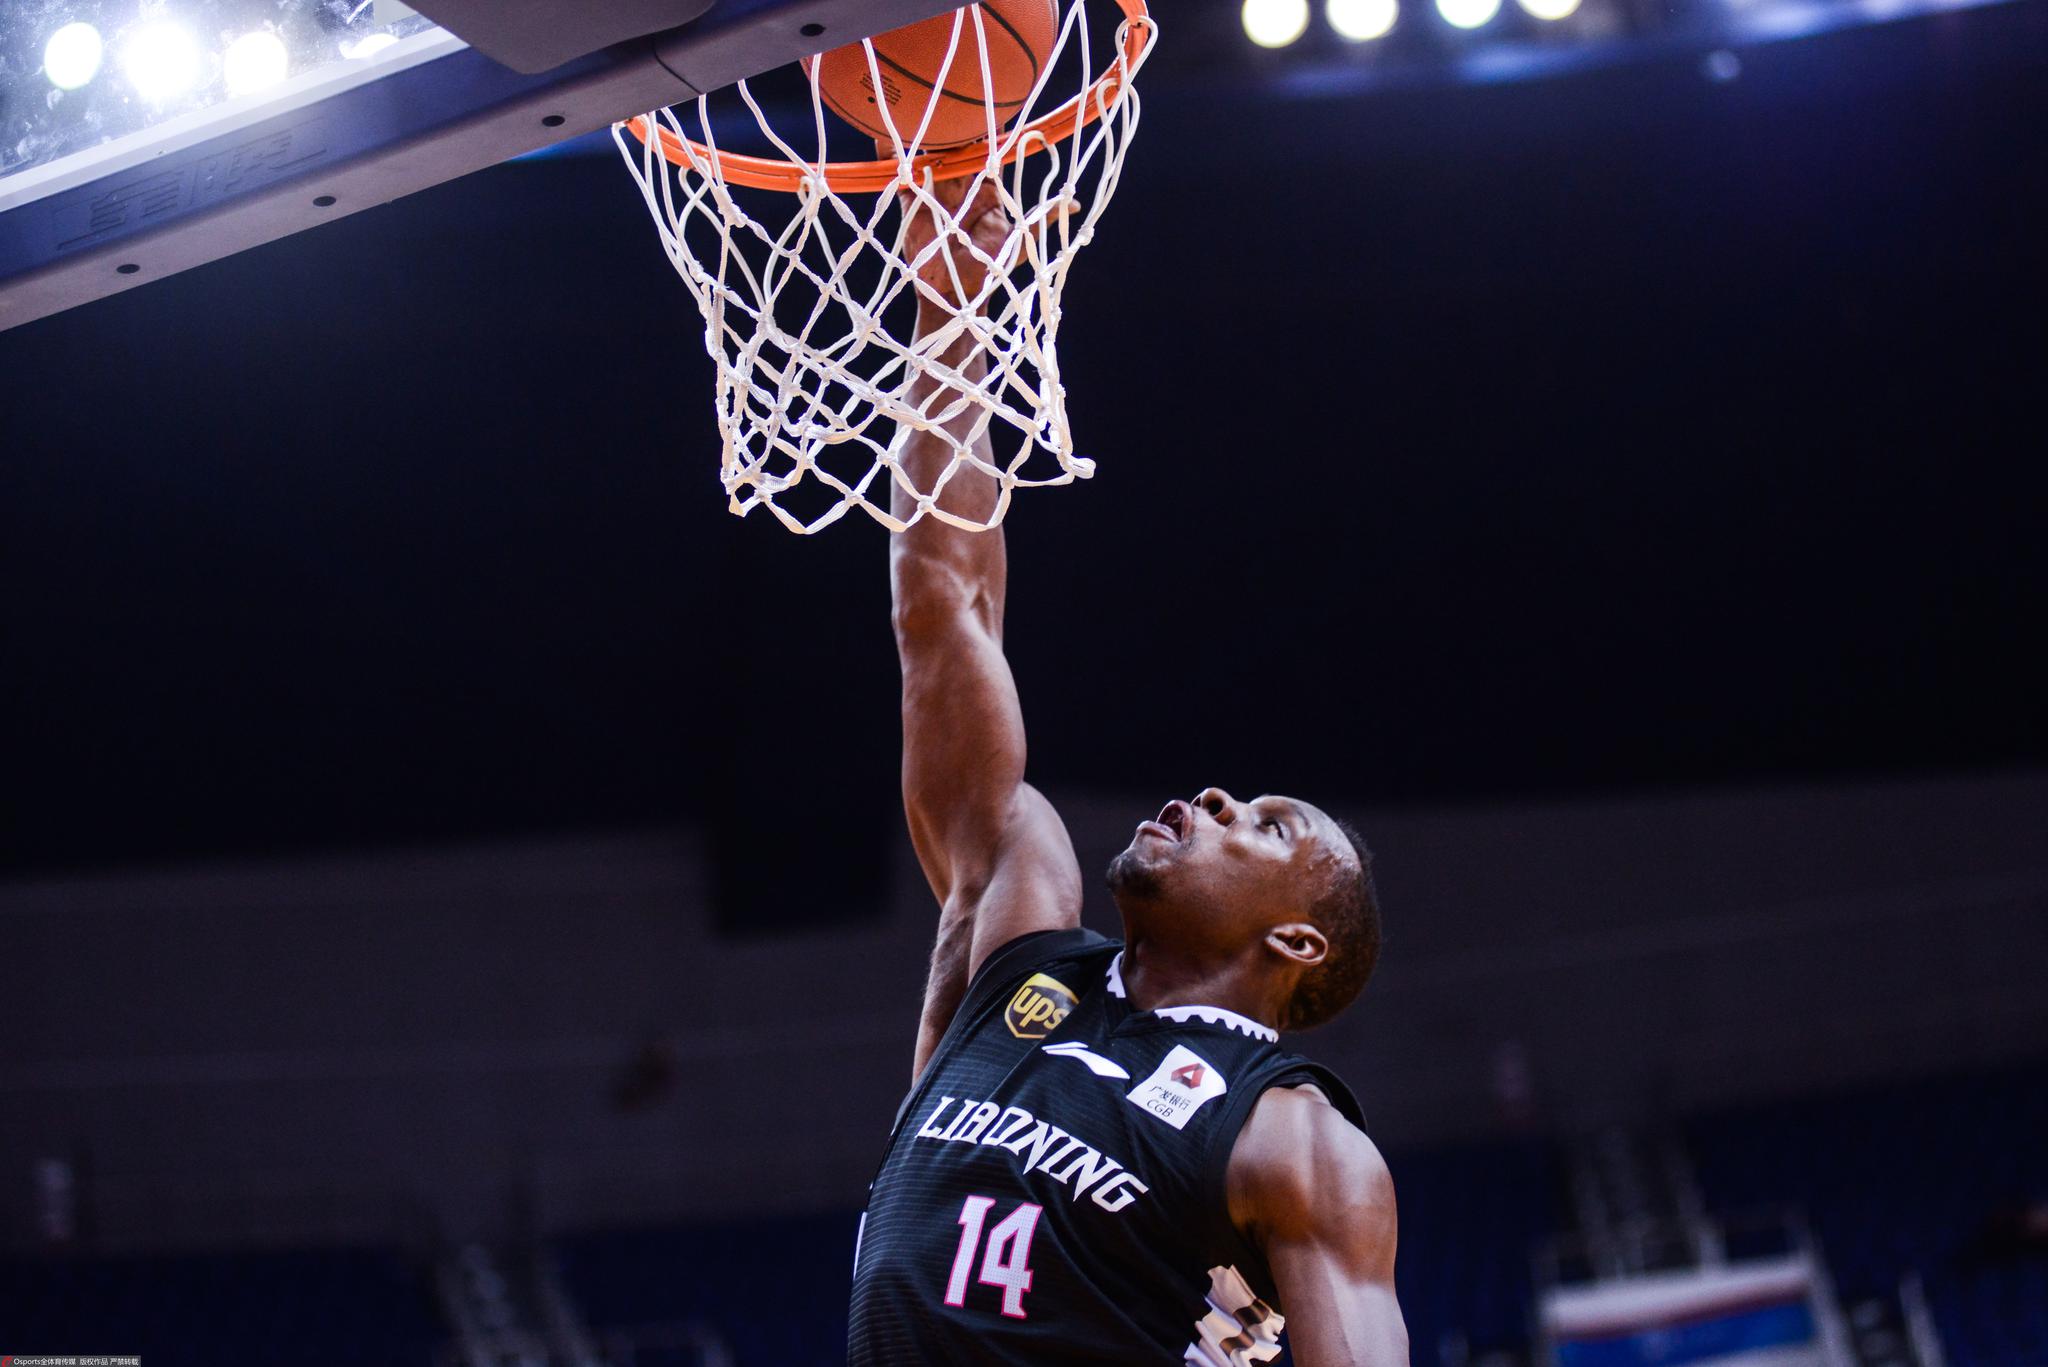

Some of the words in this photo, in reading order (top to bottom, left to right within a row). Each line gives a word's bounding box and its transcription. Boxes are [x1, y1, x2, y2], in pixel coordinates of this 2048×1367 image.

[1146, 1098, 1174, 1118] CGB
[1149, 1083, 1192, 1111] 广发银行
[915, 1096, 1149, 1213] LIAONING
[943, 1194, 1044, 1320] 14
